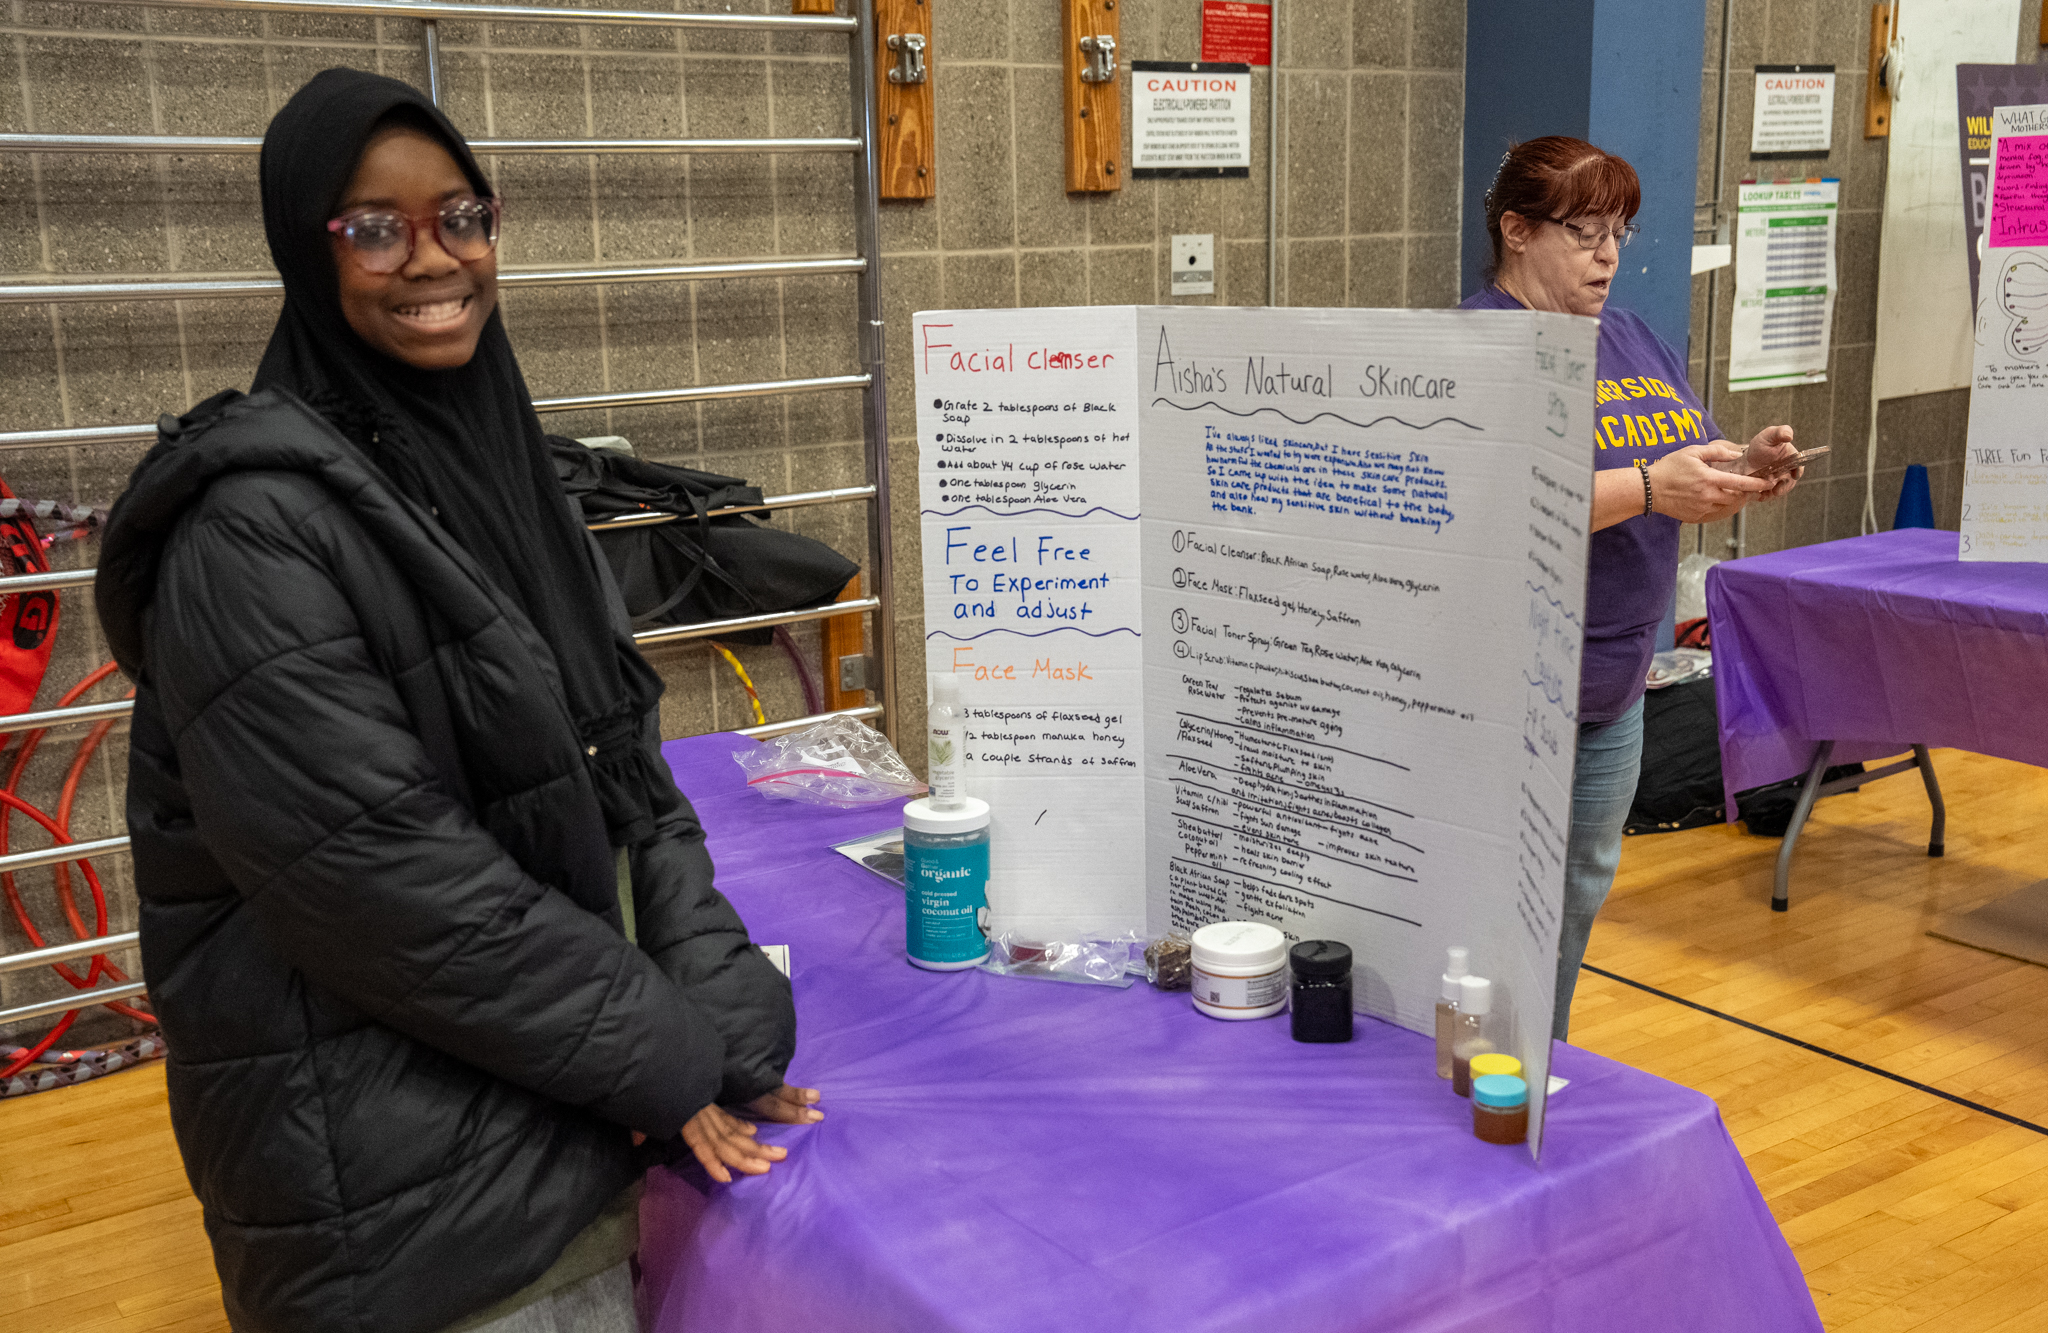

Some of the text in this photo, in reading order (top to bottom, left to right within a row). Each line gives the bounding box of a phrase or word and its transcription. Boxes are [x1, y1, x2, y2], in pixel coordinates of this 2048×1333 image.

[1147, 79, 1237, 92] CAUTION
[1765, 78, 1826, 91] CAUTION
[2000, 110, 2035, 125] WHAT
[2001, 138, 2031, 152] A mix
[2025, 162, 2036, 172] by
[1743, 191, 1774, 201] LOOKUP
[1775, 190, 1801, 200] TABLES
[1999, 202, 2046, 213] Structural
[1998, 215, 2048, 236] Intrus
[922, 323, 1015, 375] Facial
[1153, 324, 1228, 395] Aisha's
[1245, 355, 1333, 399] Natural
[2004, 363, 2040, 371] mothers
[943, 399, 1117, 417] Grate 2 tablespoons of Black
[946, 431, 1131, 449] Dissolve in 2 tablespoons of hot
[1204, 425, 1361, 457] I've always liked I have
[1216, 444, 1228, 453] the
[1249, 447, 1256, 457] I
[1283, 449, 1292, 458] to
[1293, 450, 1302, 464] try
[1387, 463, 1404, 475] may
[1405, 465, 1420, 473] not
[1971, 447, 2032, 465] THREE Fun
[947, 460, 964, 469] Add
[966, 459, 998, 470] about
[1018, 462, 1040, 477] cup
[1044, 460, 1058, 471] of
[1061, 460, 1086, 471] rose
[1089, 461, 1127, 471] water
[1249, 458, 1328, 475] the chemicals are in
[973, 478, 1078, 495] tablespoon glycerin
[1207, 465, 1217, 476] So
[1218, 466, 1226, 476] I
[1228, 468, 1252, 479] came
[1254, 470, 1267, 483] up
[1268, 473, 1289, 484] with
[1292, 475, 1310, 486] the
[1313, 478, 1336, 490] idea
[1339, 480, 1350, 490] to
[1353, 483, 1377, 494] make
[1382, 484, 1406, 497] some
[975, 493, 1088, 508] tablespoon Aloe Vera
[1210, 478, 1229, 488] skin
[1253, 481, 1289, 495] products
[1315, 492, 1331, 503] are
[1386, 498, 1400, 509] to
[1402, 500, 1422, 513] the
[1210, 490, 1226, 500] and
[1228, 490, 1248, 500] also
[1271, 497, 1283, 514] my
[1286, 499, 1326, 512] sensitive
[1328, 504, 1350, 515] skin
[1353, 508, 1395, 521] without
[1211, 501, 1228, 512] the
[946, 526, 1091, 566] Feel Free
[1187, 531, 1217, 555] Facial
[949, 572, 1110, 602] To Experiment
[1187, 571, 1208, 591] Face
[1326, 609, 1361, 627] Saffron
[953, 597, 1093, 620] and adjust
[1190, 616, 1217, 639] Facial
[1222, 624, 1247, 641] Toner
[1273, 636, 1298, 652] Green
[952, 646, 1093, 682] Face Mask
[1189, 646, 1203, 666] Lip
[1182, 674, 1204, 687] Green
[964, 707, 1123, 729] 3 tablespoons of flaxseed gel
[932, 728, 949, 736] now
[981, 731, 1126, 749] tablespoon manuka honey
[965, 752, 975, 761] a
[981, 752, 1022, 766] couple
[1081, 757, 1096, 766] of
[1178, 760, 1197, 775] Aloe
[920, 867, 971, 883] organic
[921, 889, 958, 898] cold pressed
[921, 896, 950, 908] virgin
[921, 904, 973, 916] coconut oil
